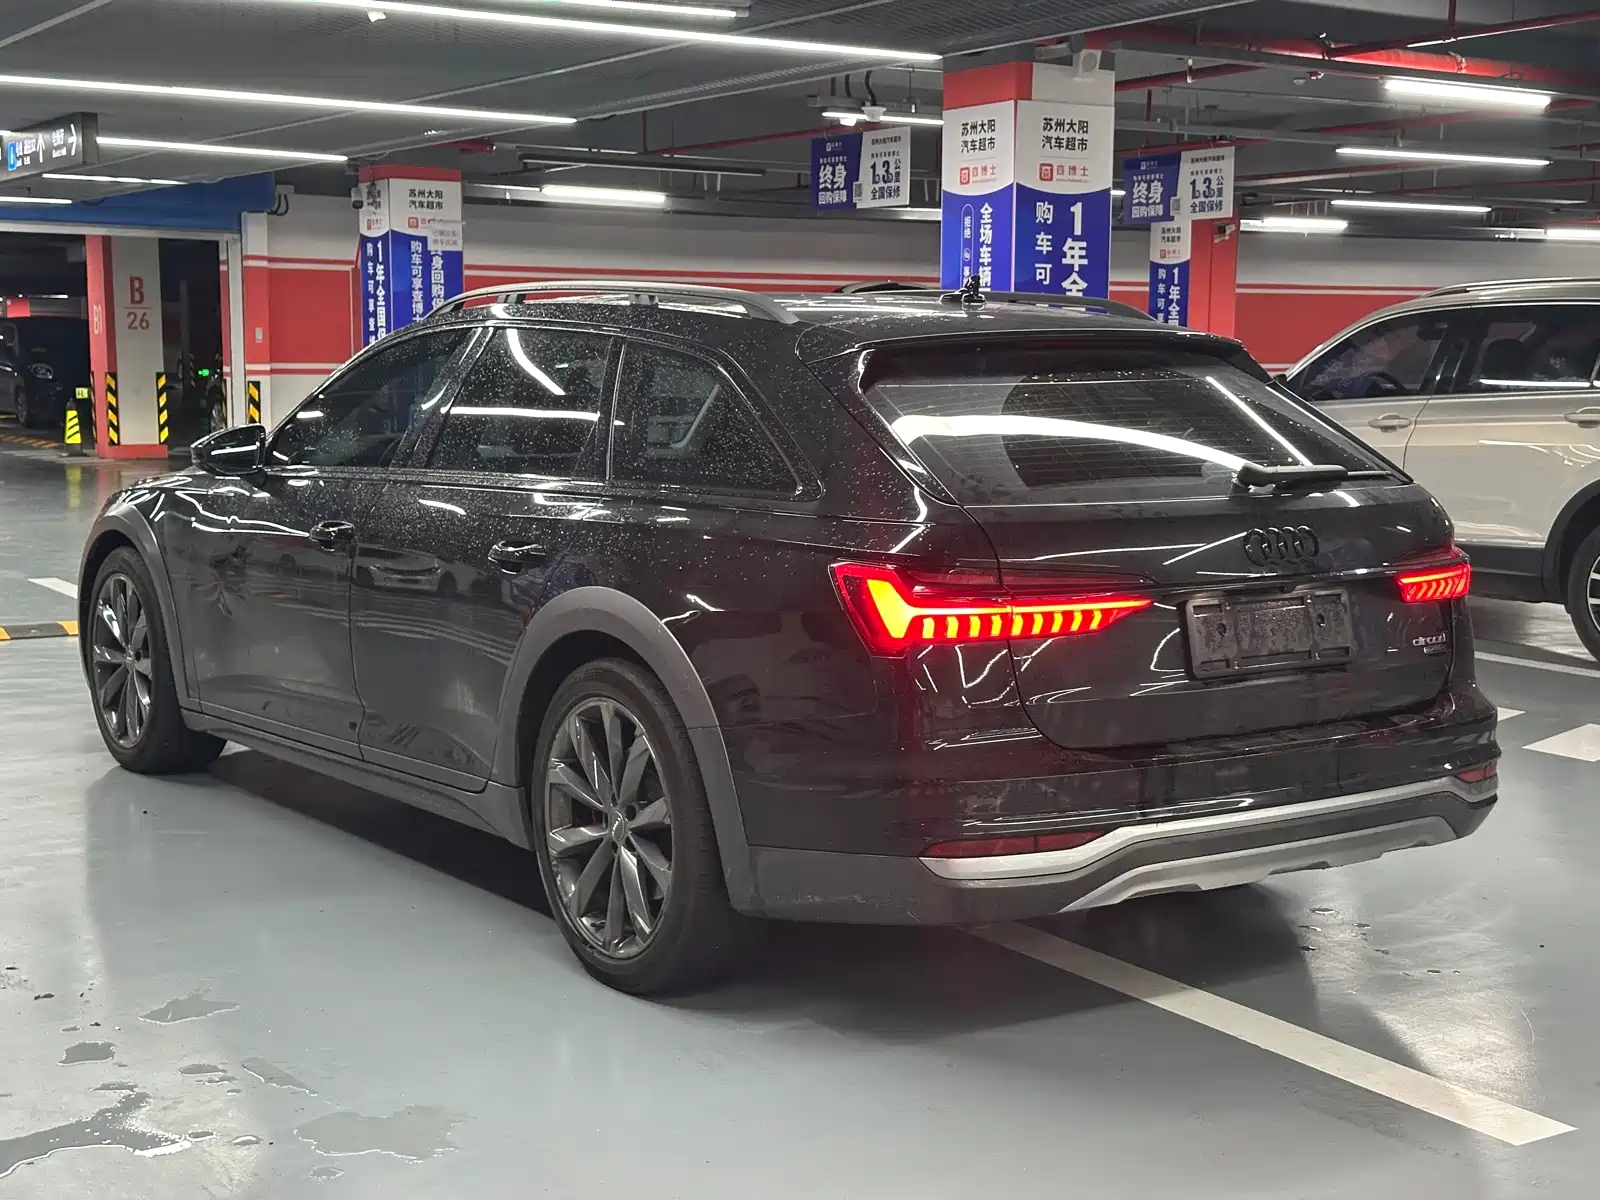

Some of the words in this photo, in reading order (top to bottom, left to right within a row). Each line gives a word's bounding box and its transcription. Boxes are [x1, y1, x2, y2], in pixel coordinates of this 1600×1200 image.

[961, 119, 996, 137] 苏州大阳
[1042, 117, 1089, 134] 苏州大阳
[961, 137, 996, 154] 汽车超市
[1041, 134, 1089, 151] 汽车超市
[819, 162, 847, 189] 终身
[408, 188, 444, 200] 苏州大阳
[870, 185, 901, 201] 全国保修
[1132, 180, 1164, 205] 终身
[408, 200, 444, 210] 汽车超市
[1190, 199, 1224, 214] 全国保修
[978, 202, 993, 292] 全场车辆
[130, 275, 144, 305] B
[126, 312, 150, 330] 26
